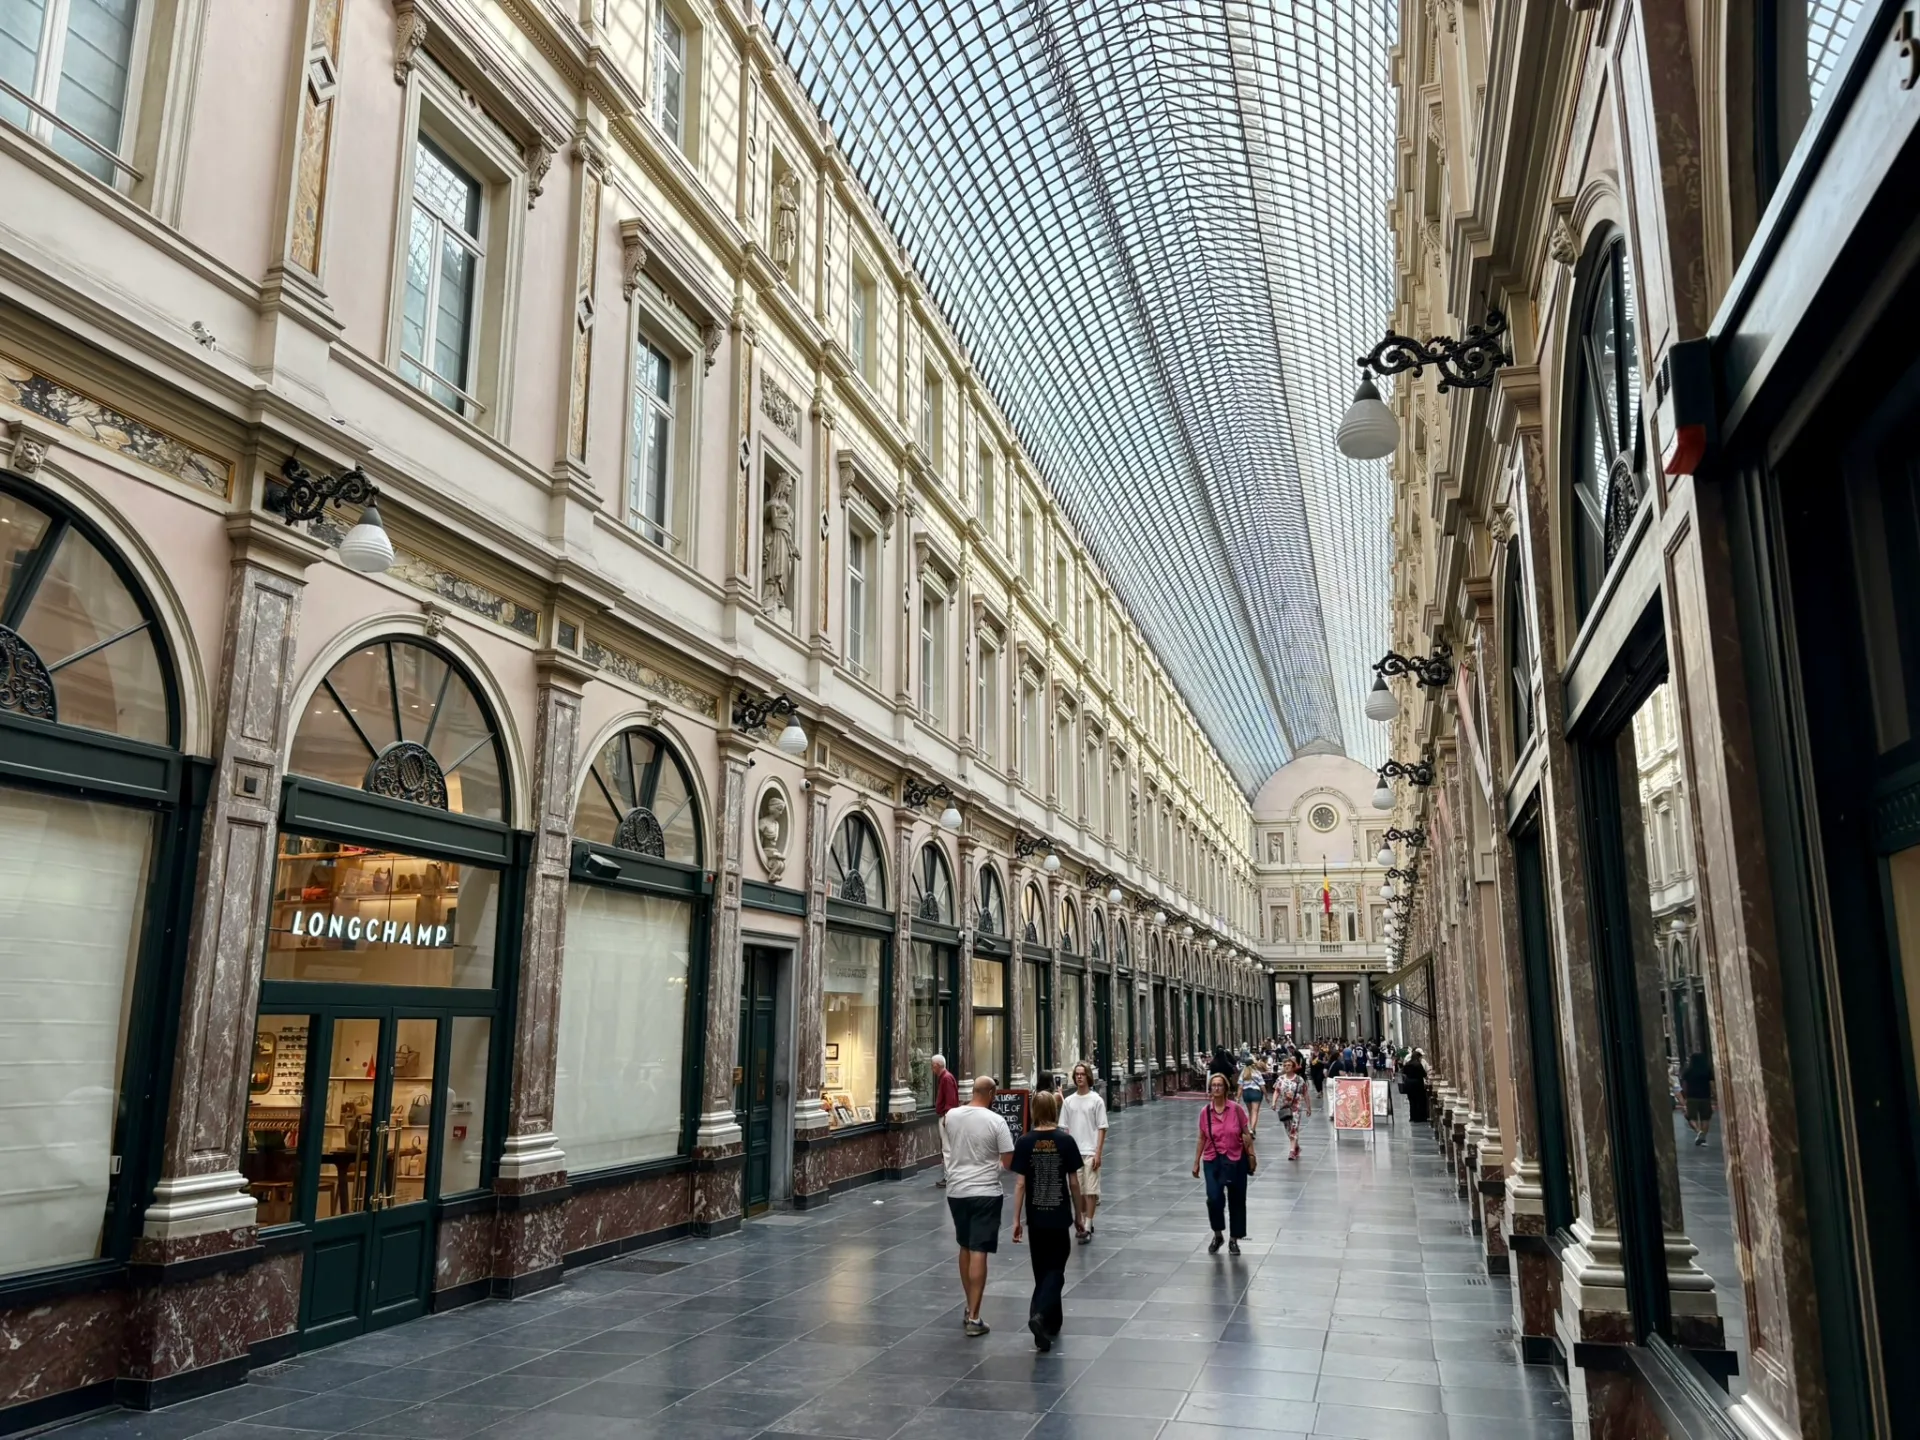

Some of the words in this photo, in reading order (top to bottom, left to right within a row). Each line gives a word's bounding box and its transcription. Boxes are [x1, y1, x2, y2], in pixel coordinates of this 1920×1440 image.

[292, 910, 448, 947] LONGCHAMP
[991, 1103, 1010, 1113] SALE
[1010, 1104, 1022, 1113] OF
